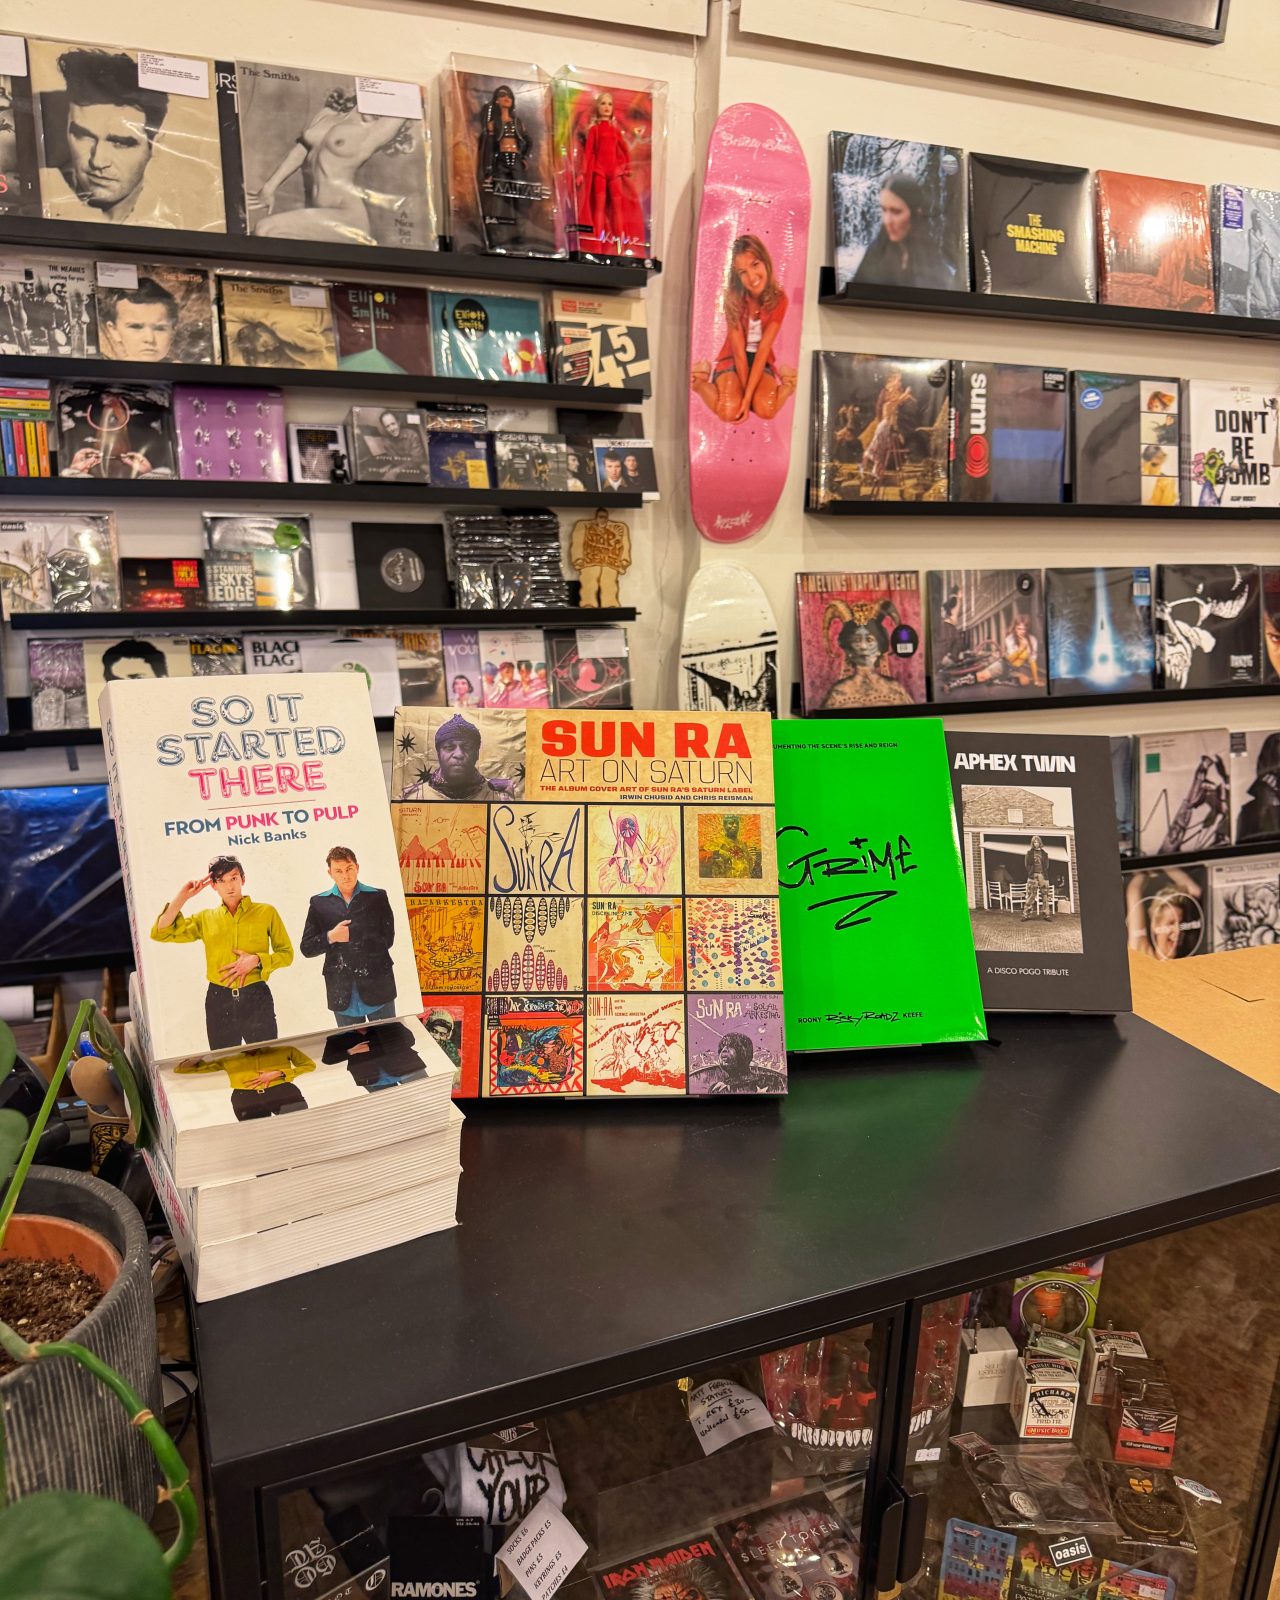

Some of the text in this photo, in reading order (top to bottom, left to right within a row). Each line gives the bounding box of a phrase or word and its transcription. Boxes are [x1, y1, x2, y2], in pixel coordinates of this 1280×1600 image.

[240, 65, 300, 82] The Smiths
[1028, 213, 1042, 228] THE
[1006, 223, 1065, 244] SMASHING
[1015, 240, 1058, 256] MACHINE
[61, 265, 85, 274] MEANIES
[231, 284, 284, 296] The Smiths
[455, 309, 486, 321] Elliott
[457, 320, 484, 330] Smith
[970, 373, 987, 435] sunn
[1215, 409, 1269, 434] DON'T
[1231, 436, 1254, 459] BE
[219, 573, 253, 586] SKY'S
[214, 586, 255, 602] EDGE
[254, 654, 294, 667] FLAG
[191, 692, 304, 728] SO IT
[156, 725, 346, 767] STARTED
[541, 719, 752, 759] SUN RA
[540, 758, 753, 785] ART ON SATURN
[953, 752, 1077, 773] APHEX TWIN
[187, 760, 327, 801] THERE
[589, 785, 618, 793] COVER
[164, 805, 360, 837] FROM PUNK TO PULP
[227, 828, 308, 848] Nick Banks
[775, 825, 918, 889] GRIME
[429, 899, 483, 907] ARKESTRA
[592, 901, 617, 910] SUN RA
[987, 967, 1070, 977] A DISCO POGO TRIBUTE
[588, 996, 614, 1017] SUN-RA
[695, 998, 743, 1020] SUN RA
[798, 1016, 822, 1024] ROONY
[902, 1011, 924, 1019] KEEFE
[588, 1019, 642, 1049] INTERSTELLAR
[643, 1008, 660, 1022] LOW
[700, 1387, 734, 1406] STATUES
[706, 1404, 724, 1419] REX
[506, 1527, 529, 1555] SOCKS £6
[516, 1519, 552, 1566] BADGE PACKS £5
[740, 1520, 841, 1564] SLEEP TOKEN
[1055, 1542, 1087, 1561] oasis
[525, 1552, 544, 1578] PINS £5
[533, 1559, 556, 1590] KEYRINGS
[602, 1541, 718, 1590] IRON MAIDEN
[391, 1582, 478, 1598] RAMONES
[541, 1564, 569, 1600] PATCHES £4
